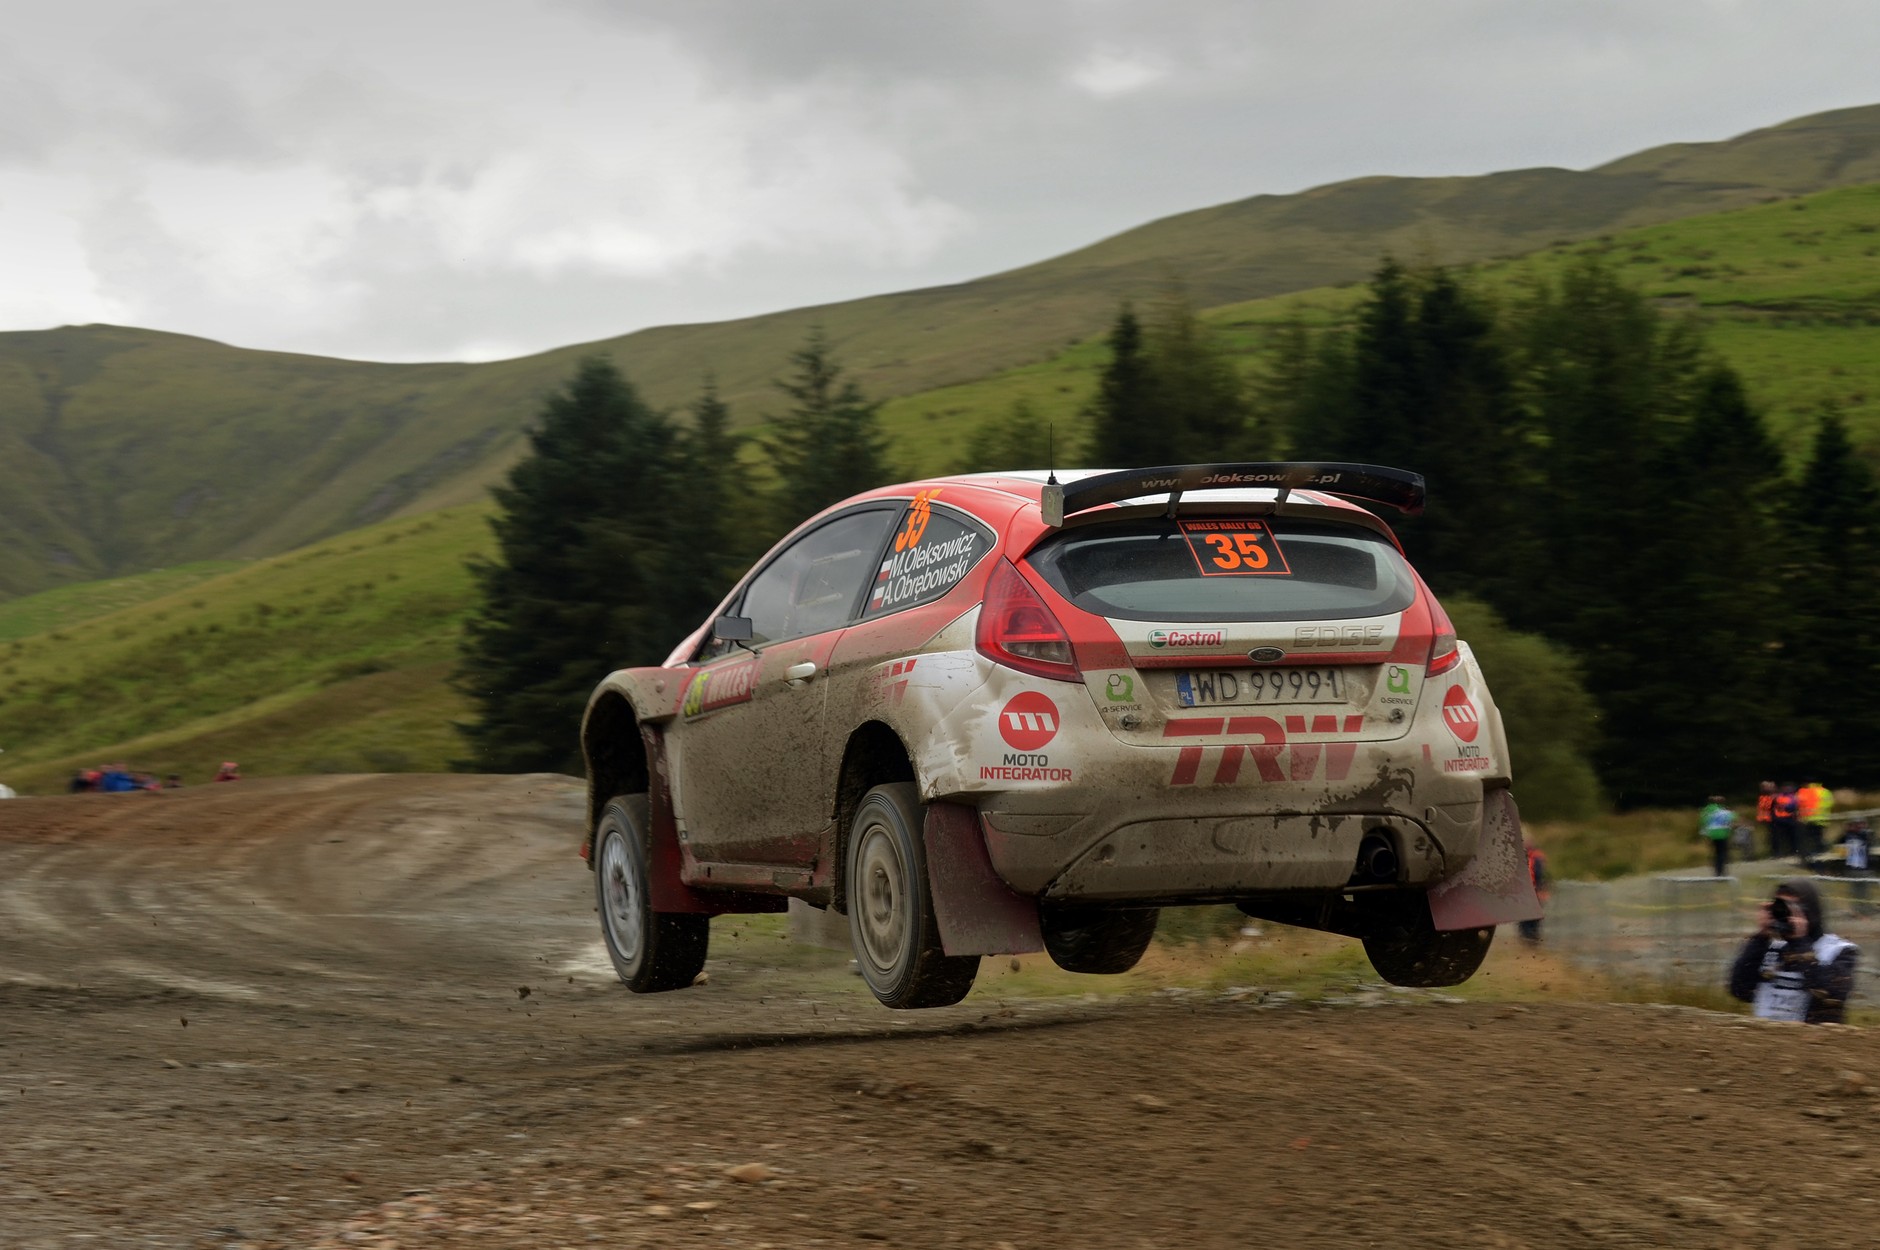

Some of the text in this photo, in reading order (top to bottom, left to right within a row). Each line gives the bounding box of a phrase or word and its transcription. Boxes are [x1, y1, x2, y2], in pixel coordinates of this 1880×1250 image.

[1185, 521, 1262, 531] WALES RALLY GB
[888, 530, 977, 580] M.Oleksowicz
[1205, 533, 1269, 569] 35
[1167, 631, 1222, 647] Castrol
[1292, 624, 1385, 648] EDGE
[1195, 670, 1339, 702] WD 99991
[1180, 691, 1192, 700] PL
[1162, 714, 1365, 786] TRW
[1457, 745, 1480, 758] MOTO
[1002, 753, 1049, 767] MOTO
[1444, 757, 1490, 772] INTEGRATOR
[979, 766, 1073, 782] INTEGRATOR
